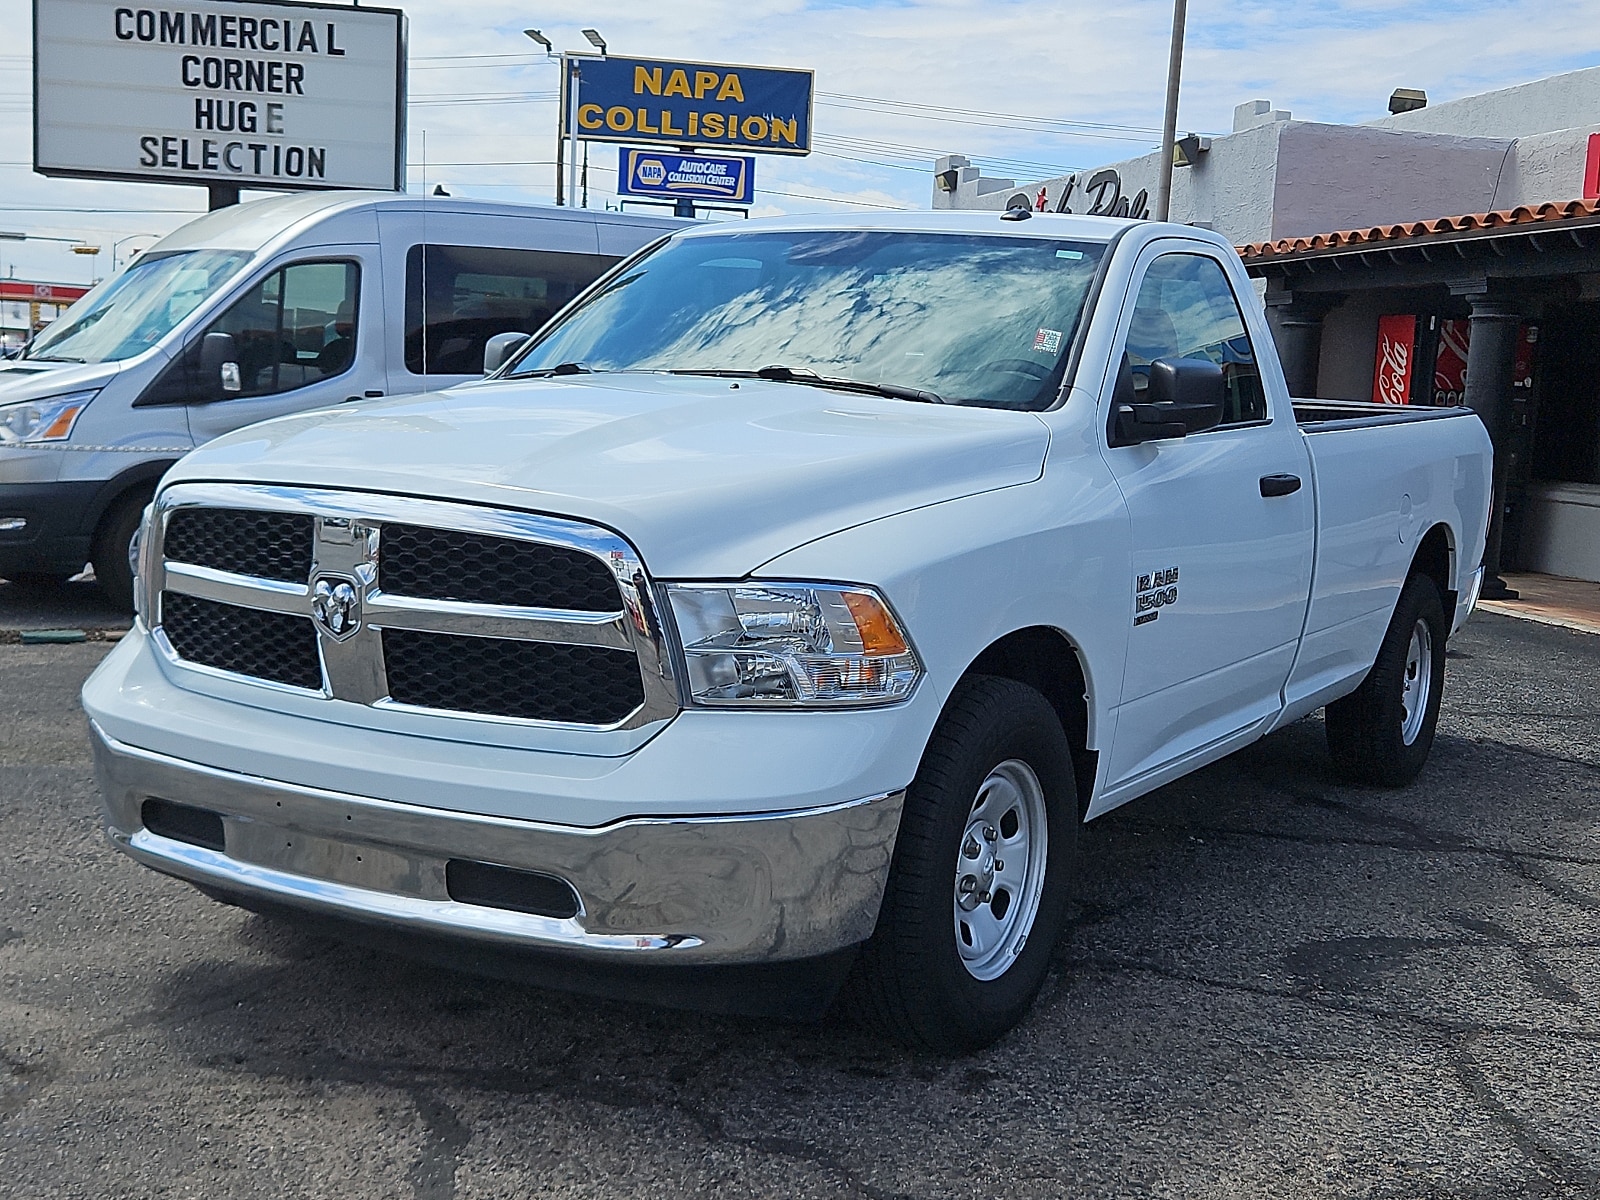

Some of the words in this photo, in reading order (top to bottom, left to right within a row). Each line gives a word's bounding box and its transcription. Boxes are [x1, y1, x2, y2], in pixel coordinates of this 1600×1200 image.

[115, 8, 345, 55] COMMERCIAL
[181, 54, 305, 95] CORNER
[633, 66, 745, 102] NAPA
[194, 97, 285, 134] HUGE
[577, 104, 798, 143] COLLISION
[139, 136, 327, 178] SELECTION
[641, 166, 663, 179] NAPA
[667, 171, 706, 184] COLLISION
[706, 174, 736, 187] CENTER
[1136, 567, 1179, 594] RAM
[1136, 587, 1178, 613] 1500
